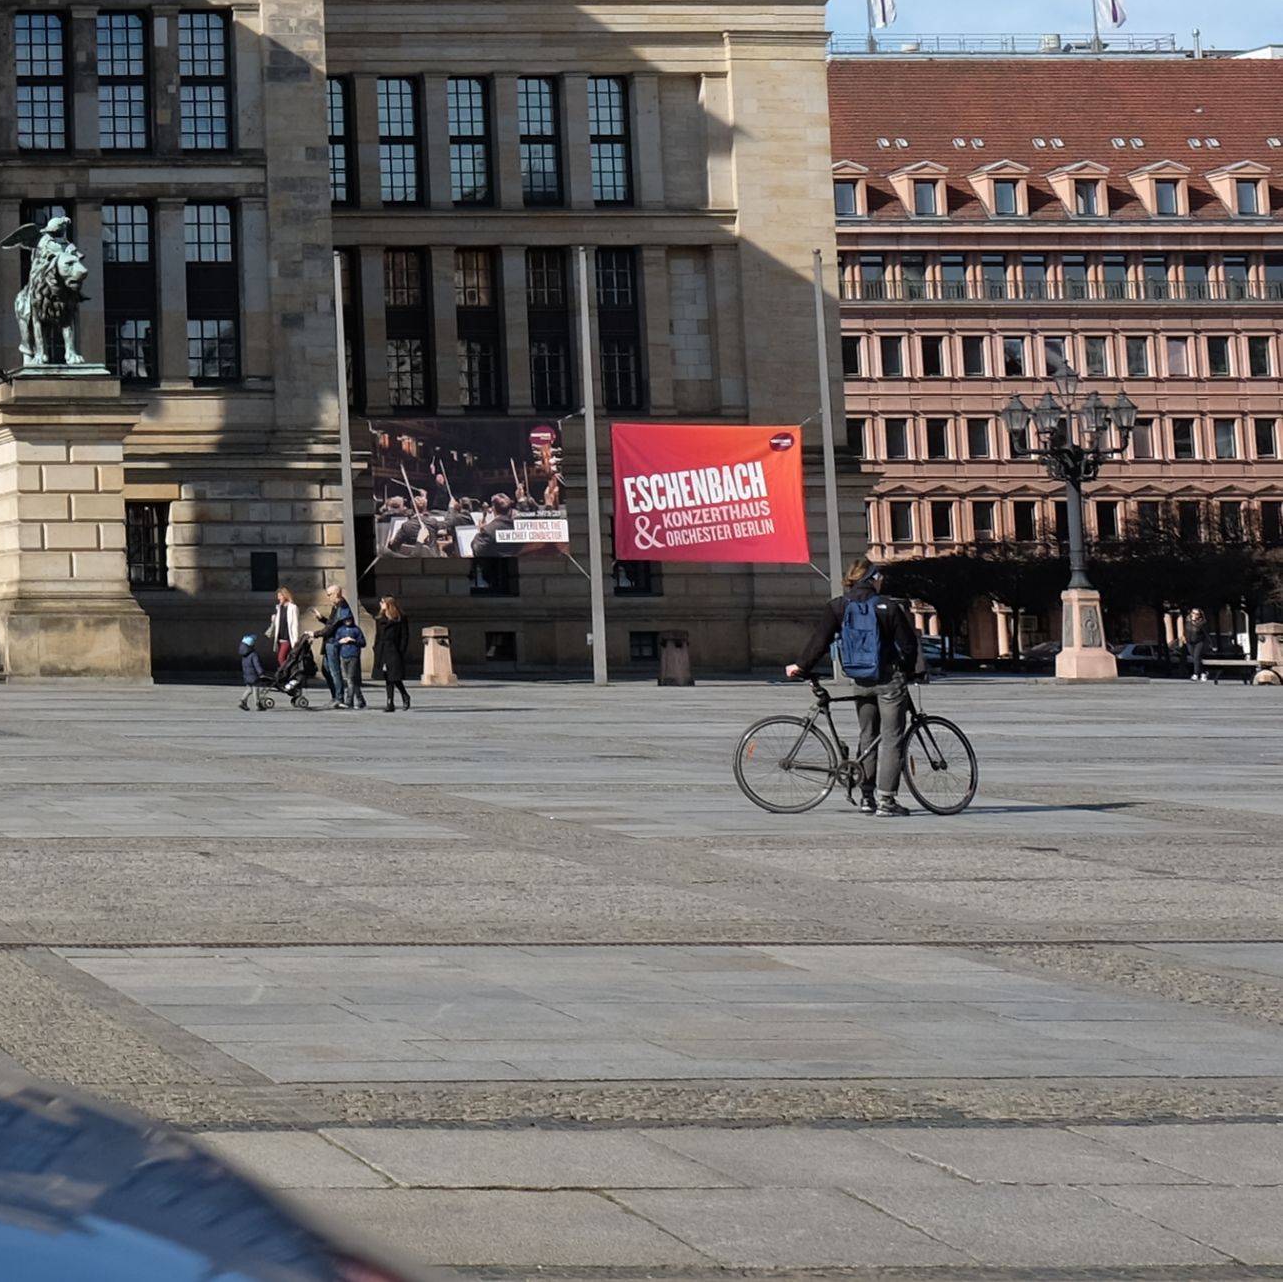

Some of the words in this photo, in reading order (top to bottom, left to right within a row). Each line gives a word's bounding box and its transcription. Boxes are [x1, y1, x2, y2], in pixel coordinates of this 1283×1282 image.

[623, 460, 768, 514] ESCHENBACH
[661, 500, 770, 529] KONZERTHAUS
[634, 515, 666, 550] &
[665, 524, 733, 548] ORCHESTER
[734, 518, 774, 539] BERLIN
